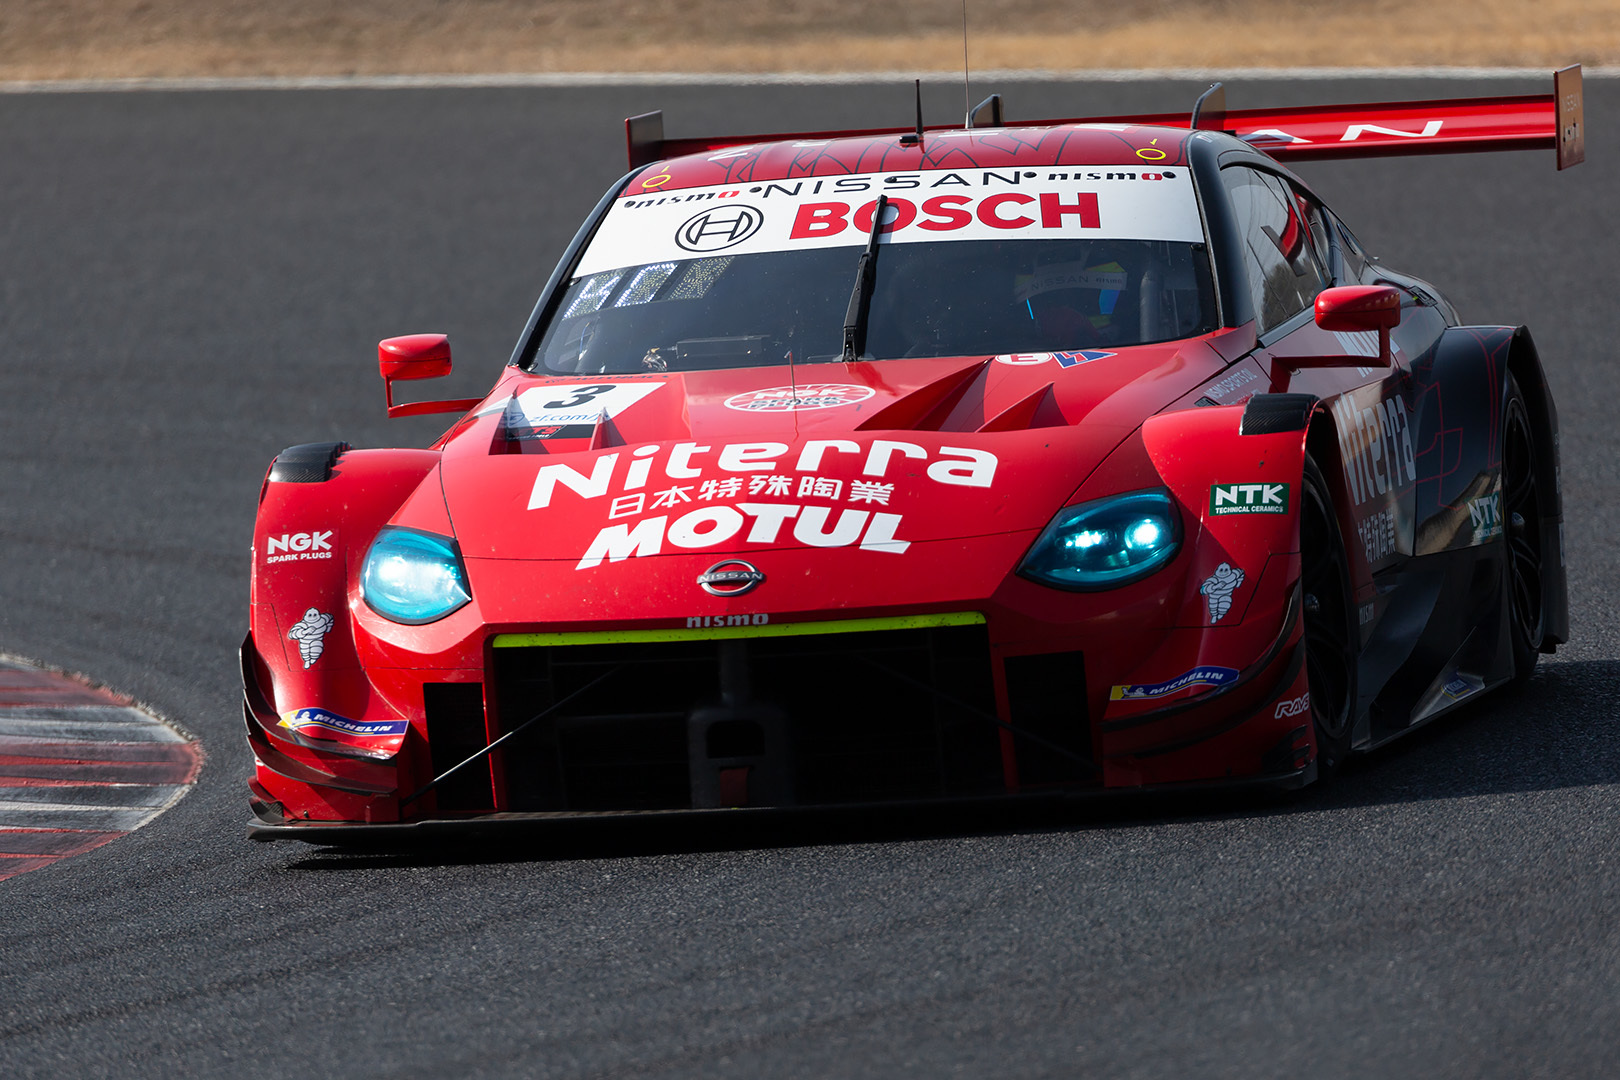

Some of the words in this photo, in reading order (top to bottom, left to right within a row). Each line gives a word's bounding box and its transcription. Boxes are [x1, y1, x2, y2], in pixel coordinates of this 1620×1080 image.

[763, 170, 1021, 199] NISSAN
[1048, 171, 1163, 181] nismo
[635, 190, 741, 209] nismo
[789, 192, 1101, 240] BOSCH
[1031, 274, 1090, 291] NISSAN
[543, 384, 617, 409] 3
[753, 388, 850, 399] NGK
[527, 439, 998, 510] Niterra
[608, 474, 896, 520] 日本特殊陶業
[1215, 484, 1284, 506] NTK
[1215, 505, 1251, 514] TECHNICAL
[1250, 505, 1284, 513] CERAMICS
[1467, 494, 1501, 527] NTK
[267, 530, 333, 555] NGK
[575, 502, 911, 570] MOTUL
[267, 553, 298, 564] SPARK
[300, 551, 332, 560] PLUGS
[699, 572, 763, 583] NISSAN
[686, 613, 769, 628] nismo
[1149, 672, 1224, 695] MICHELIN
[314, 713, 393, 733] MICHELIN
